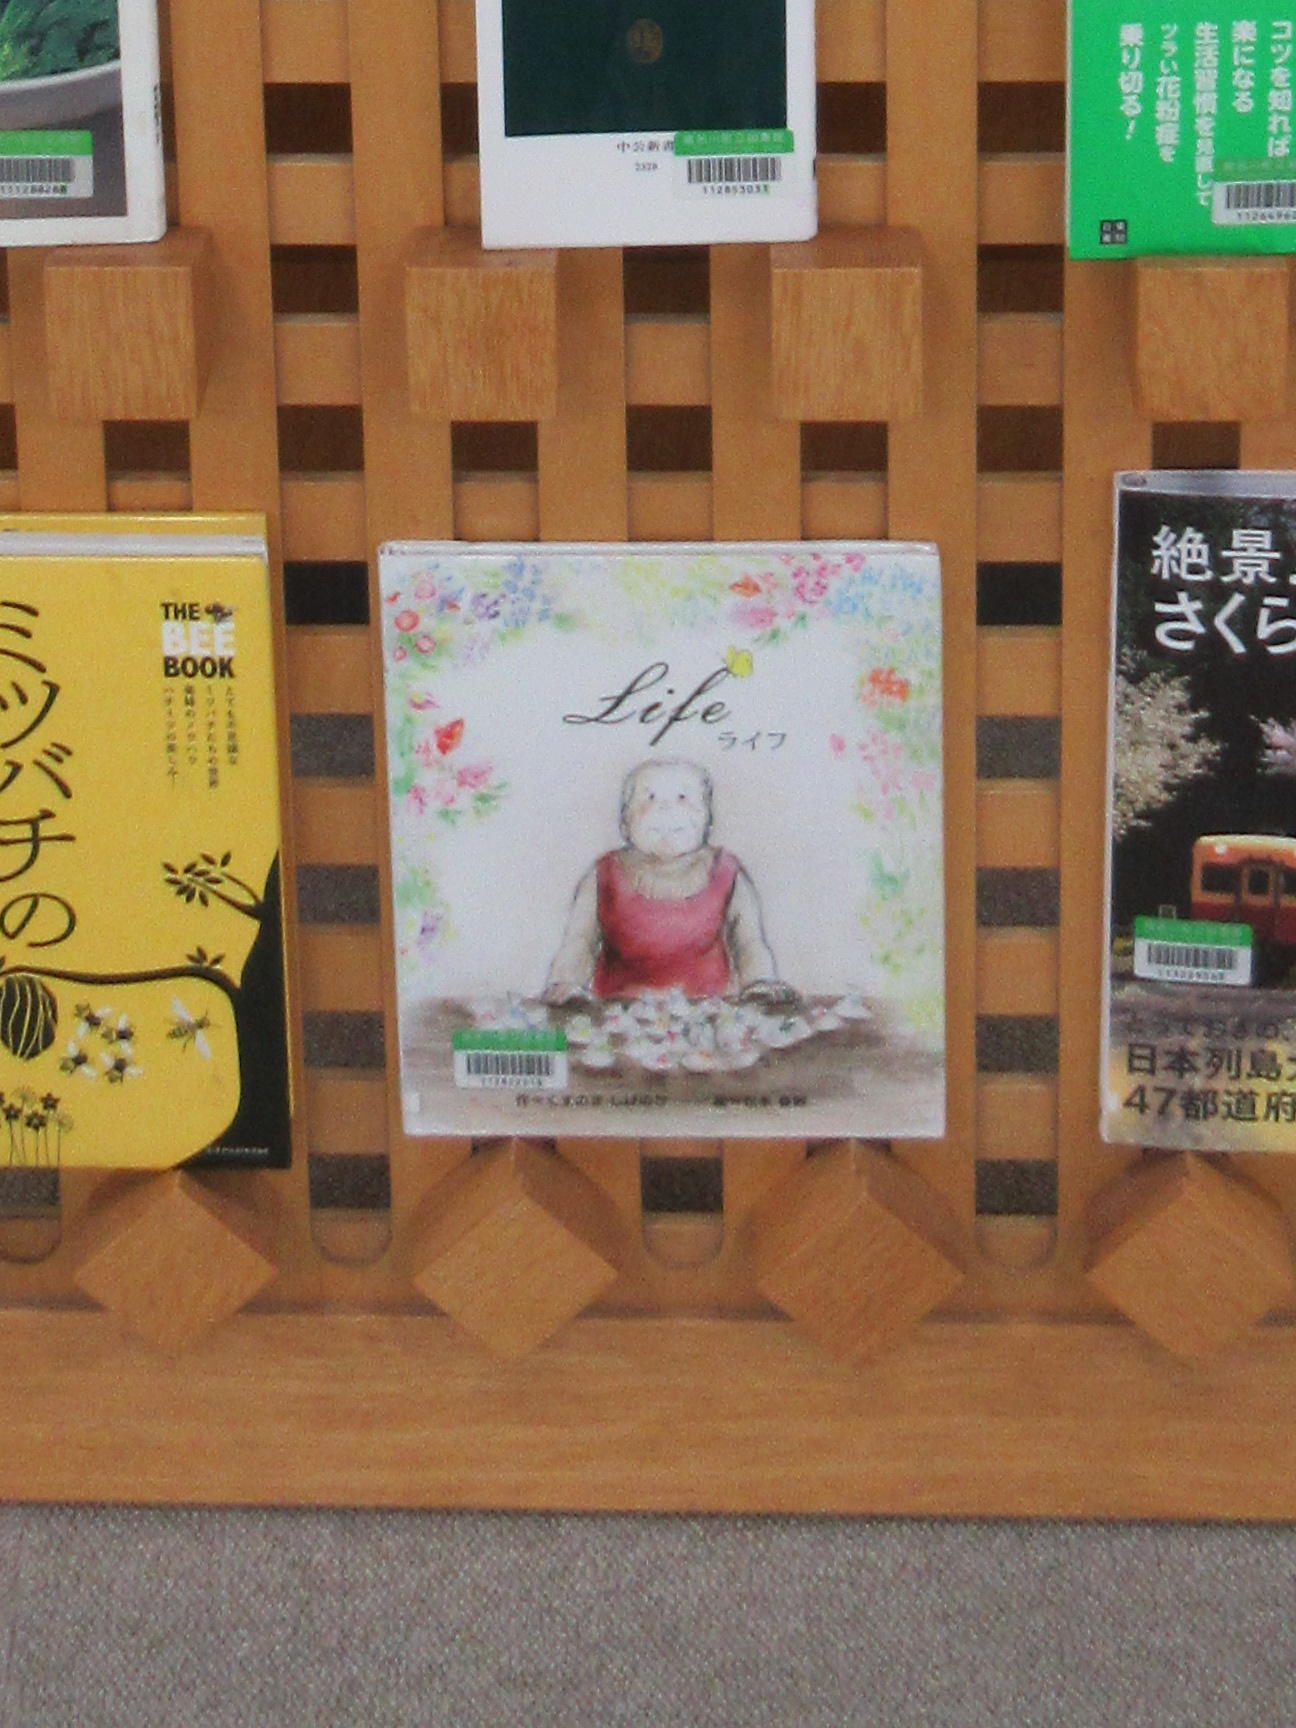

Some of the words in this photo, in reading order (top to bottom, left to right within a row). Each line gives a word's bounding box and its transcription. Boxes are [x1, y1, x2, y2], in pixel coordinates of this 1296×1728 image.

[1231, 19, 1258, 115] 楽になる
[1268, 20, 1294, 159] コツを知れば
[161, 602, 201, 621] THE
[161, 621, 237, 657] BEE
[163, 656, 235, 679] BOOK
[562, 661, 734, 747] Life
[717, 730, 788, 751] ライフ
